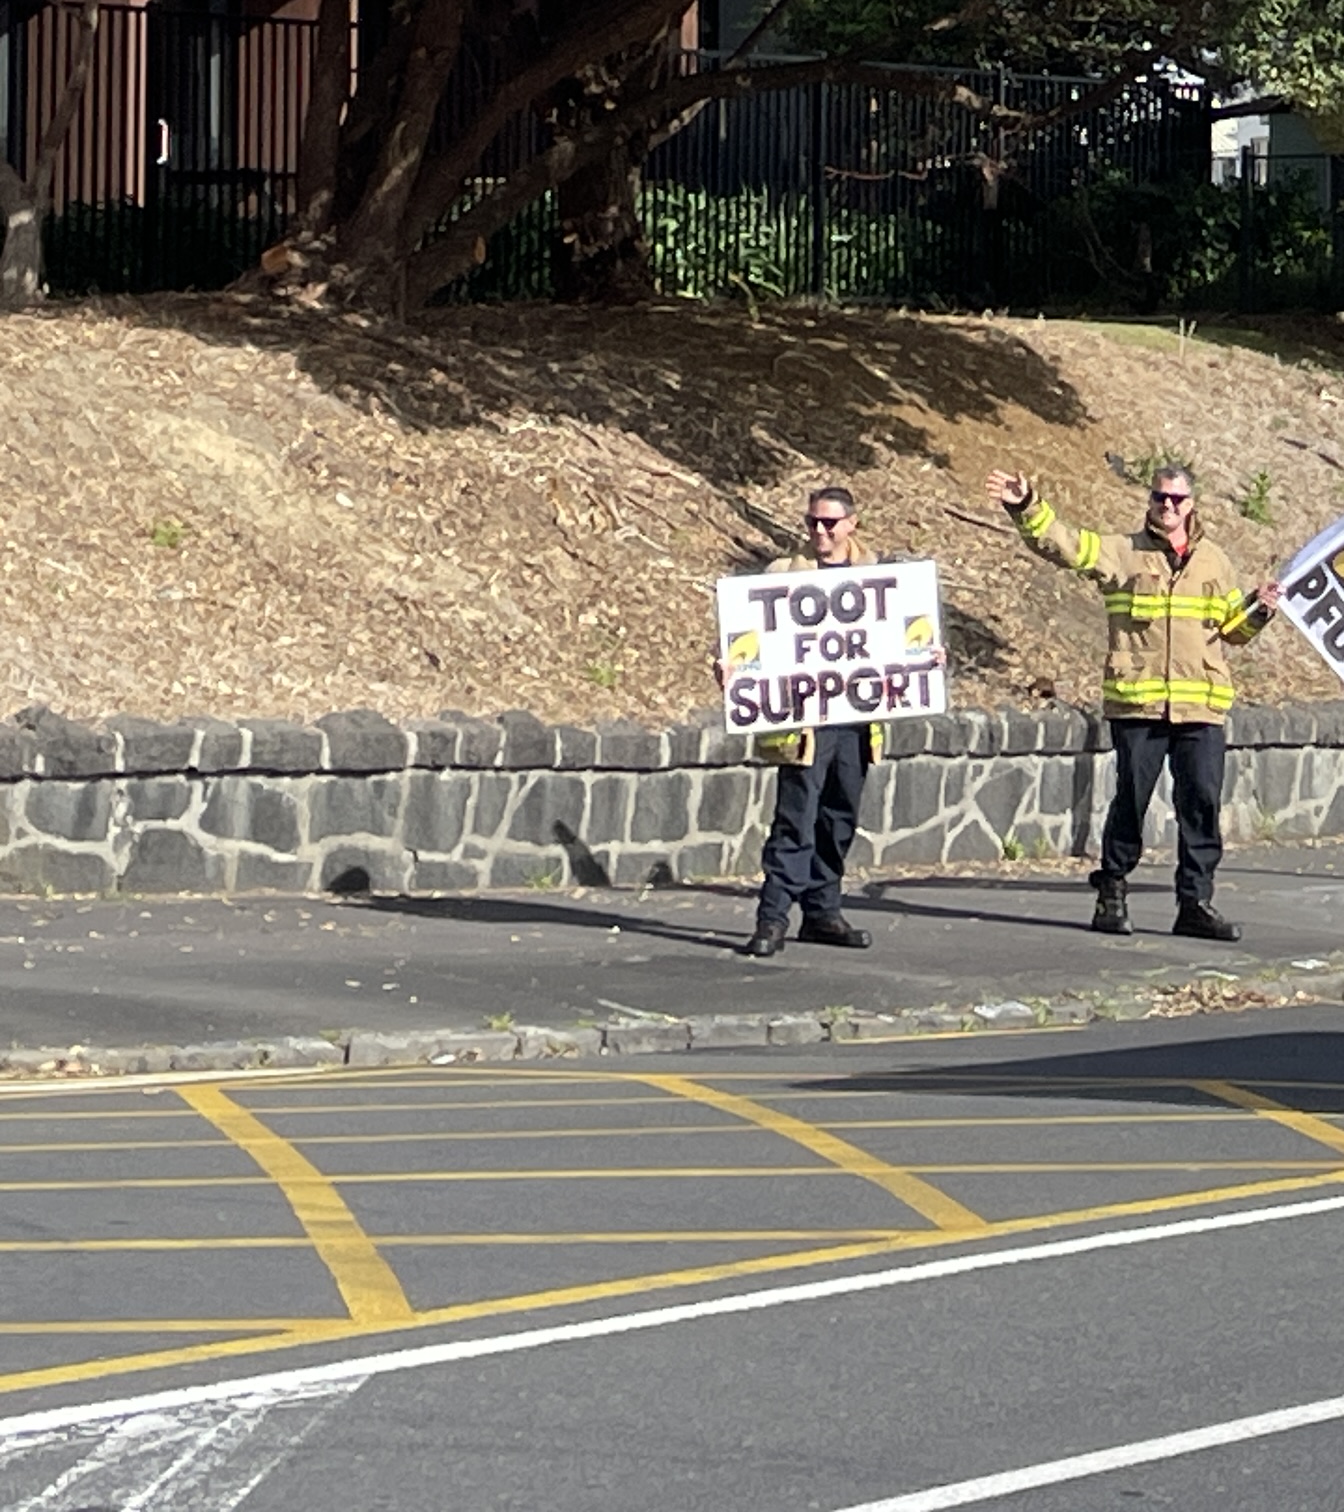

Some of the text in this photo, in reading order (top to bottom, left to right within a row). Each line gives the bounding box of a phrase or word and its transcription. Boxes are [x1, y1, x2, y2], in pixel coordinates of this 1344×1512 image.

[748, 576, 897, 632] TOOT
[794, 629, 870, 663] FOR
[729, 658, 939, 726] SUPPORT
